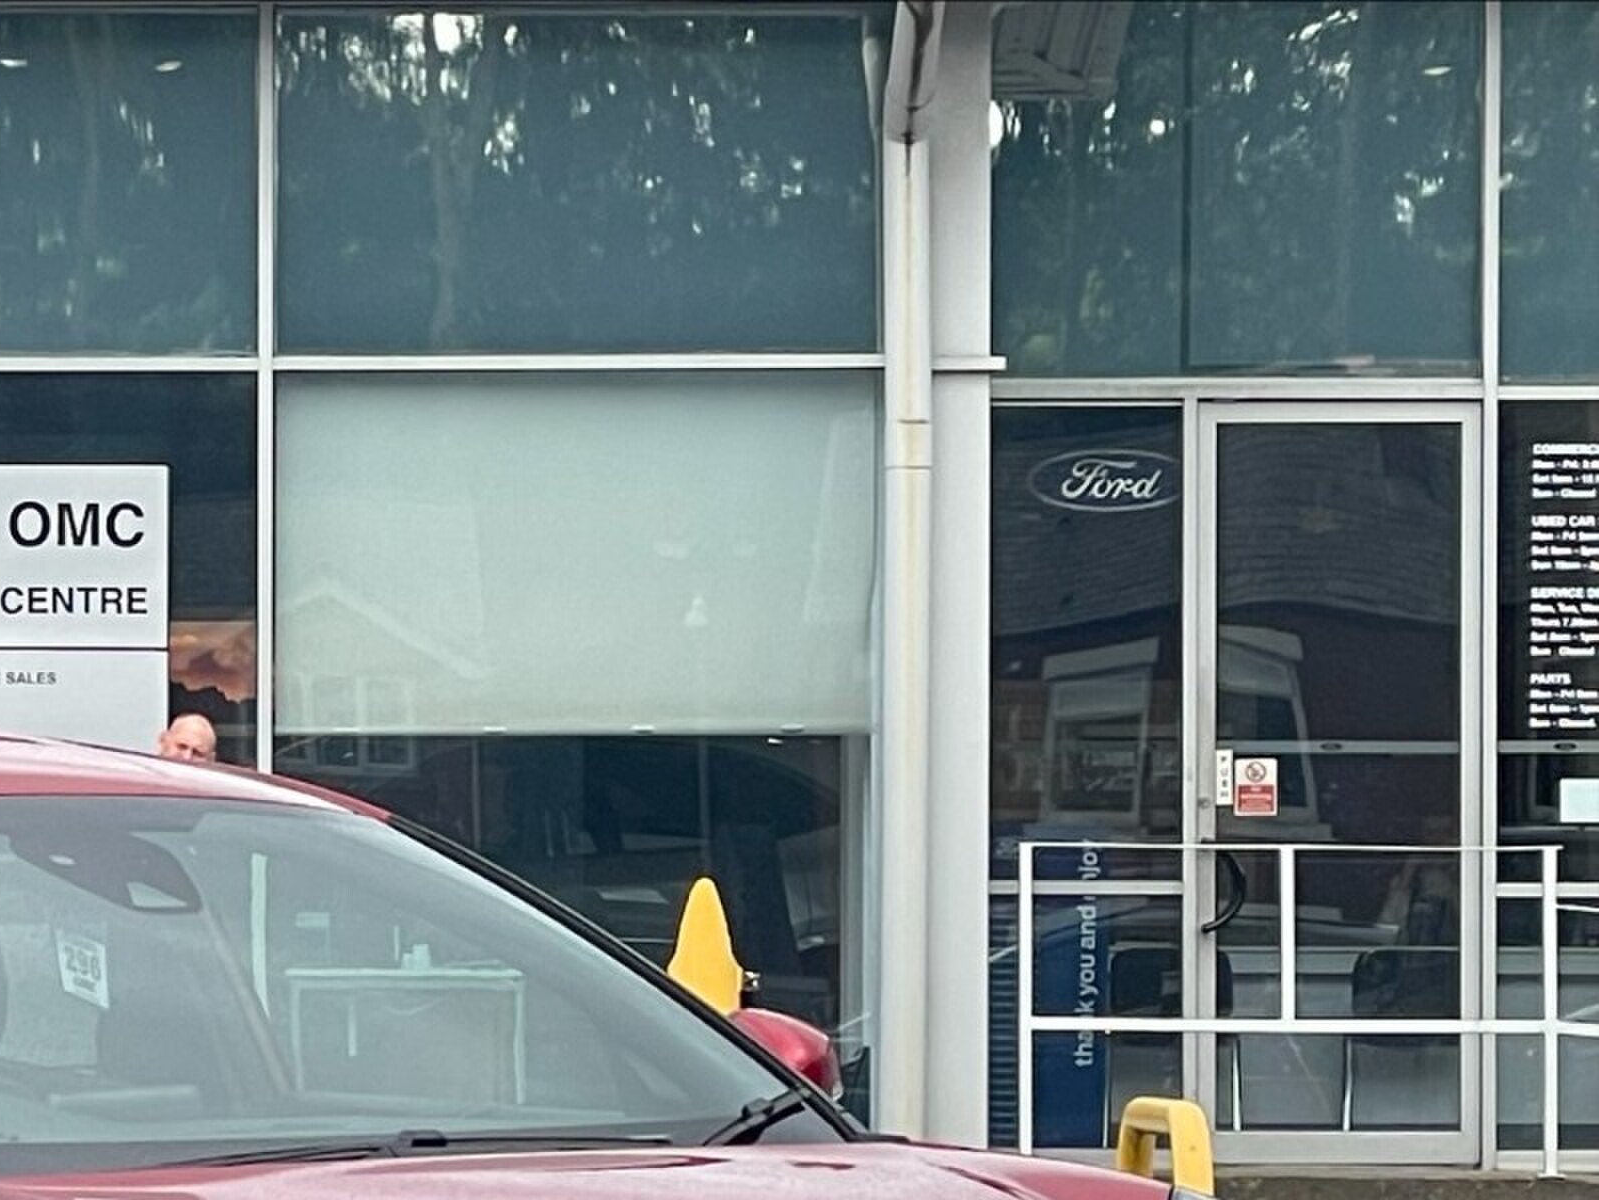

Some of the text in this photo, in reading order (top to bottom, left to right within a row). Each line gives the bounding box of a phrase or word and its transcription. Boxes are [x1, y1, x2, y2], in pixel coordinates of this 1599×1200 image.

[1061, 457, 1163, 499] Ford
[8, 500, 146, 548] OMC
[1568, 515, 1596, 527] CAR
[0, 586, 149, 616] CENTRE
[1530, 586, 1585, 599] SERVICE
[5, 671, 58, 685] SALES
[1530, 673, 1572, 685] PARTS
[1077, 907, 1096, 950] and
[1079, 953, 1099, 996] you
